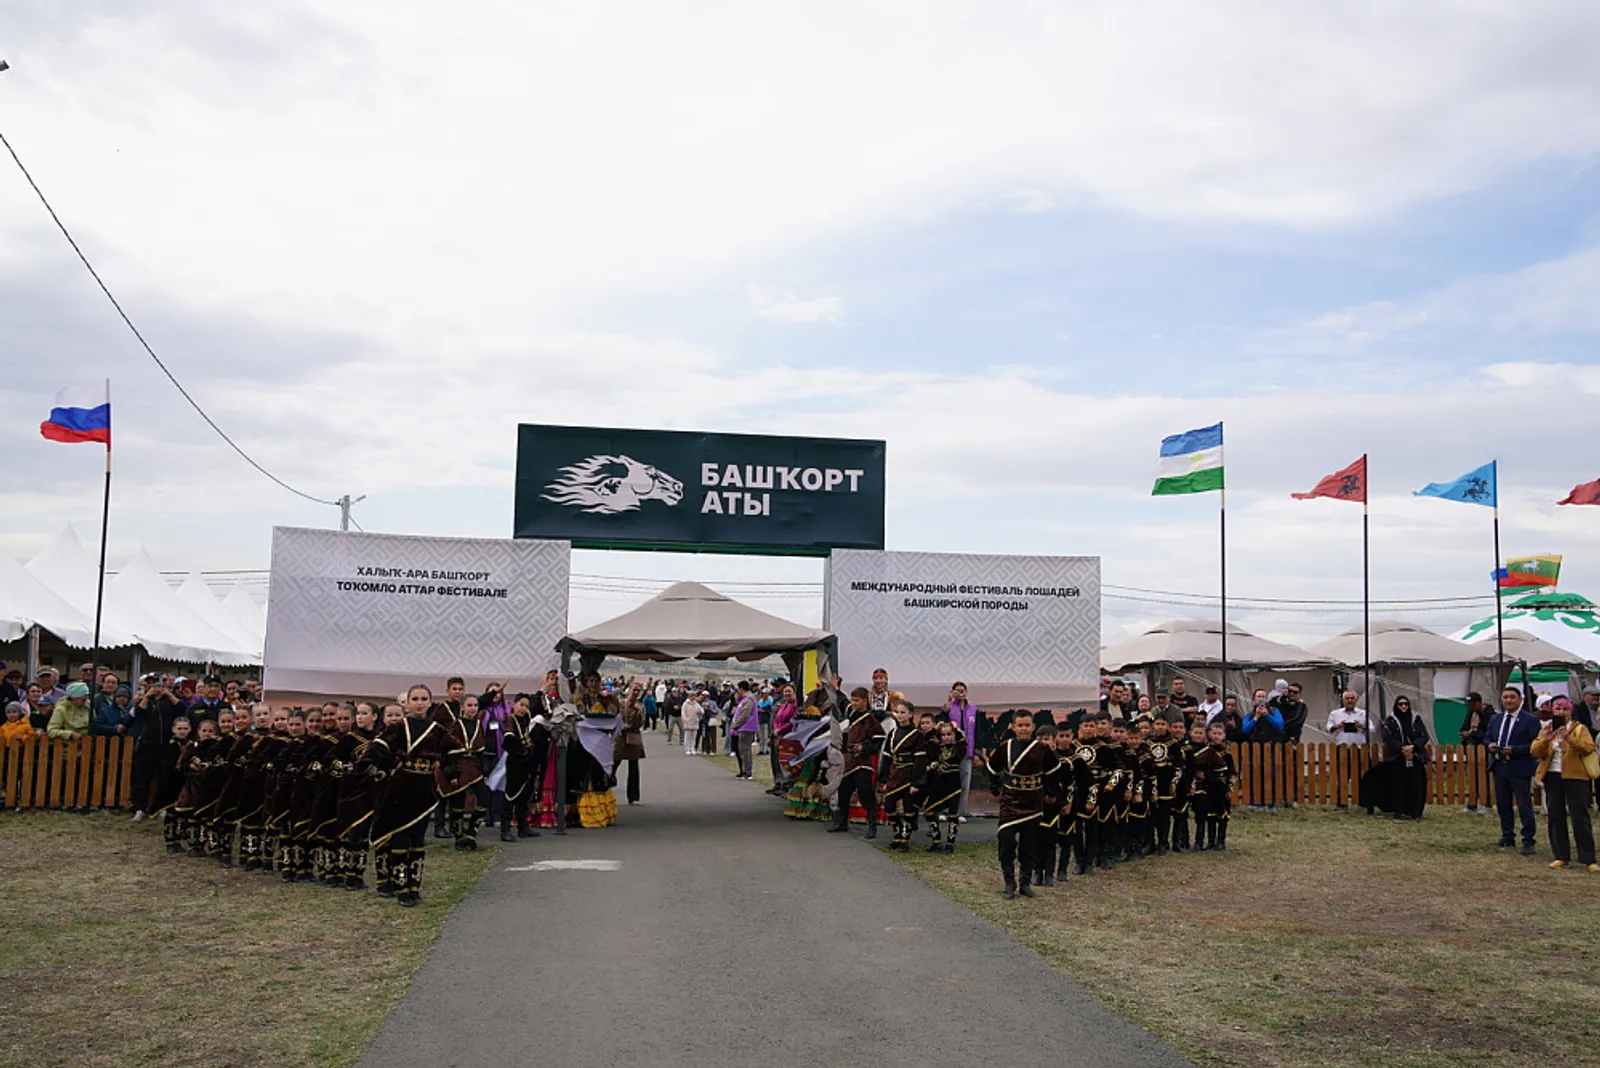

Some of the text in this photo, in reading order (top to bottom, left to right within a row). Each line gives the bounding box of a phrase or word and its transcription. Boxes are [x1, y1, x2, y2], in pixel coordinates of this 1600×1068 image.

[701, 491, 770, 516] АТЫ
[398, 585, 435, 595] АТТАР
[437, 587, 508, 598] ФЕСТИВАЛЕ
[850, 582, 1080, 597] МЕЖДУНАРОДНЫЙ ФЕСТИВАЛЬ ЛОШАДЕЙ
[904, 598, 1029, 610] БАШКИРСКОЙ ПОРОДЫ
